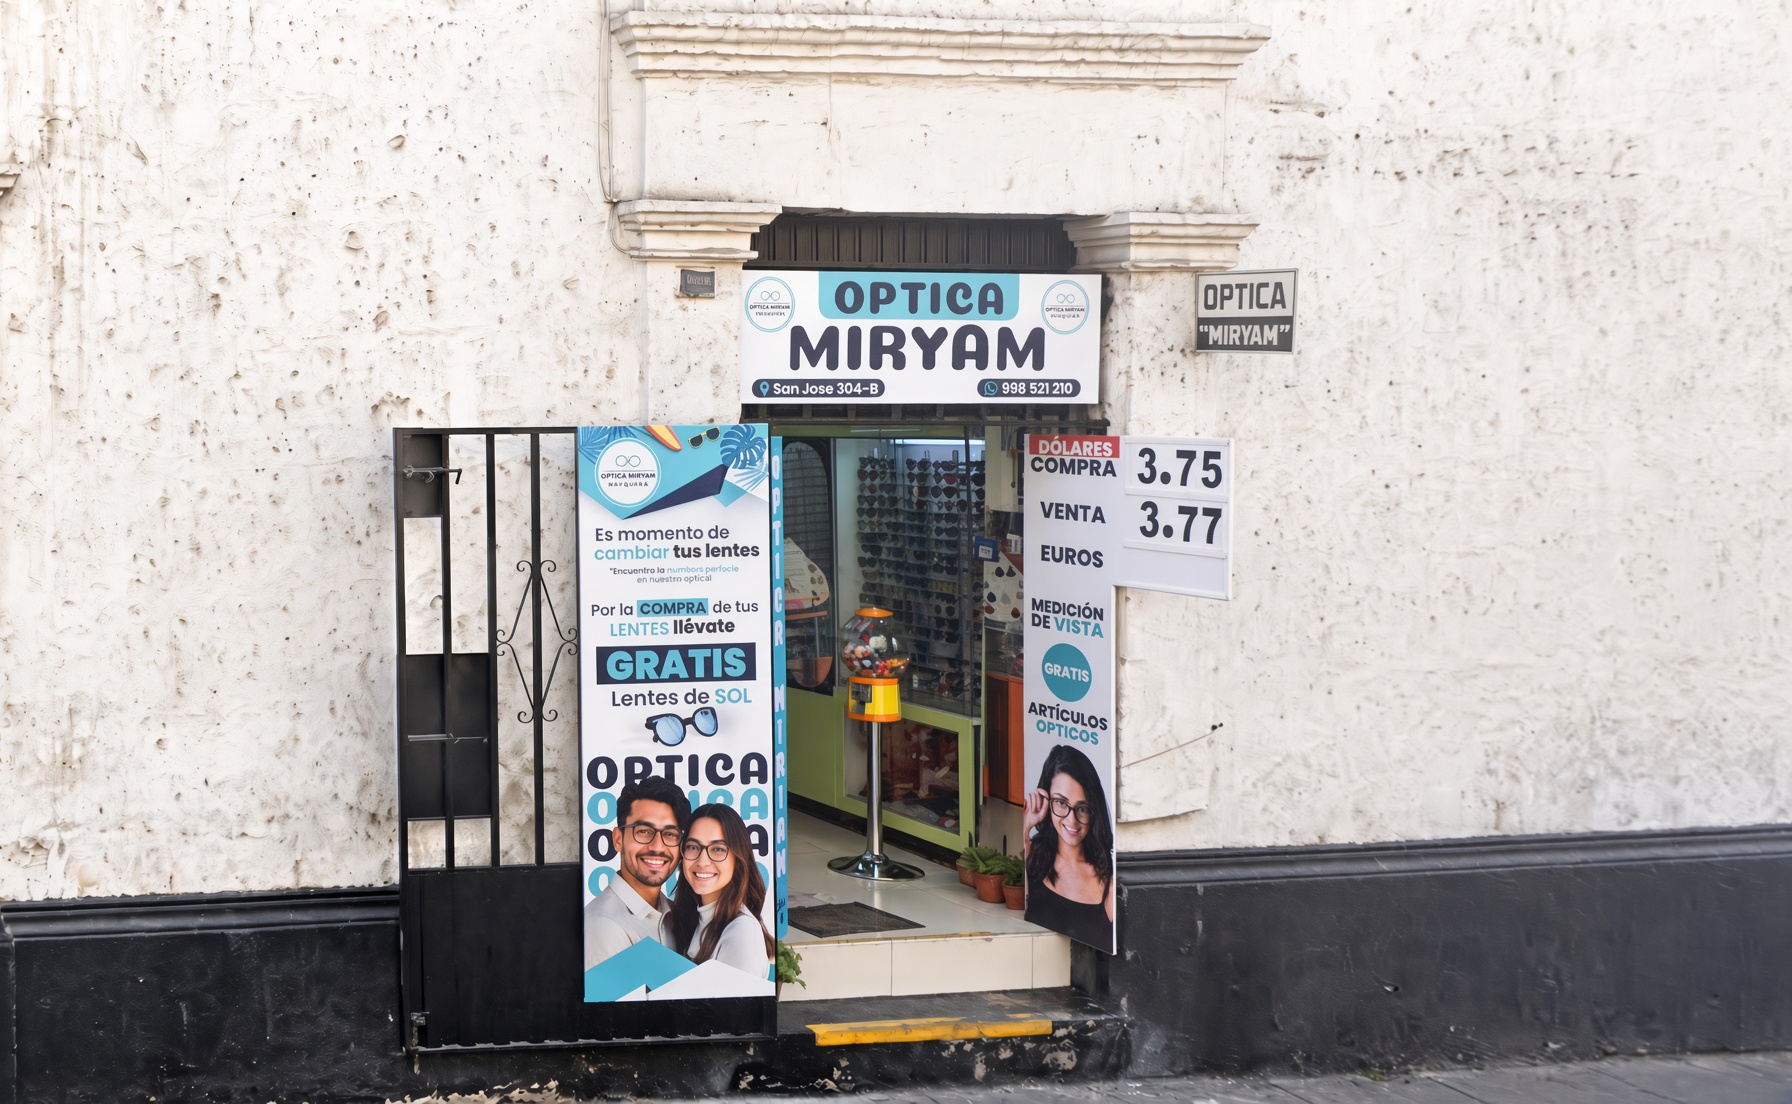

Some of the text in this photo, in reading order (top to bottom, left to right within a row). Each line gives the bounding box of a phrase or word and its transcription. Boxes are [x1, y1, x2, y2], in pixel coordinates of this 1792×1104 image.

[834, 280, 1004, 315] OPTICA
[1203, 281, 1287, 311] OPTICA
[789, 323, 1046, 371] MIRYAM
[773, 382, 879, 395] San Jose 304-B
[1001, 382, 1073, 395] 998 521 210
[1038, 436, 1113, 458] DÓLARES
[1030, 456, 1117, 478] COMPRA
[1137, 447, 1223, 489] 3.75
[1040, 501, 1106, 524] VENTA
[1139, 500, 1223, 545] 3.77
[595, 525, 730, 542] Es momento de
[594, 543, 760, 561] cambiar tus lentes
[1040, 544, 1104, 568] EUROS
[591, 600, 759, 617] Por la COMPRA de tus
[1031, 598, 1104, 621] MEDICIÓN
[610, 617, 735, 637] LENTES llévate
[1031, 613, 1104, 639] DE VISTA
[606, 647, 747, 681] GRATIS
[1044, 662, 1090, 683] GRATIS
[611, 688, 752, 707] Lentes de SOL
[1028, 702, 1108, 731] ARTÍCULOS
[1036, 719, 1099, 746] OPTICOS
[586, 752, 768, 790] OPTICA
